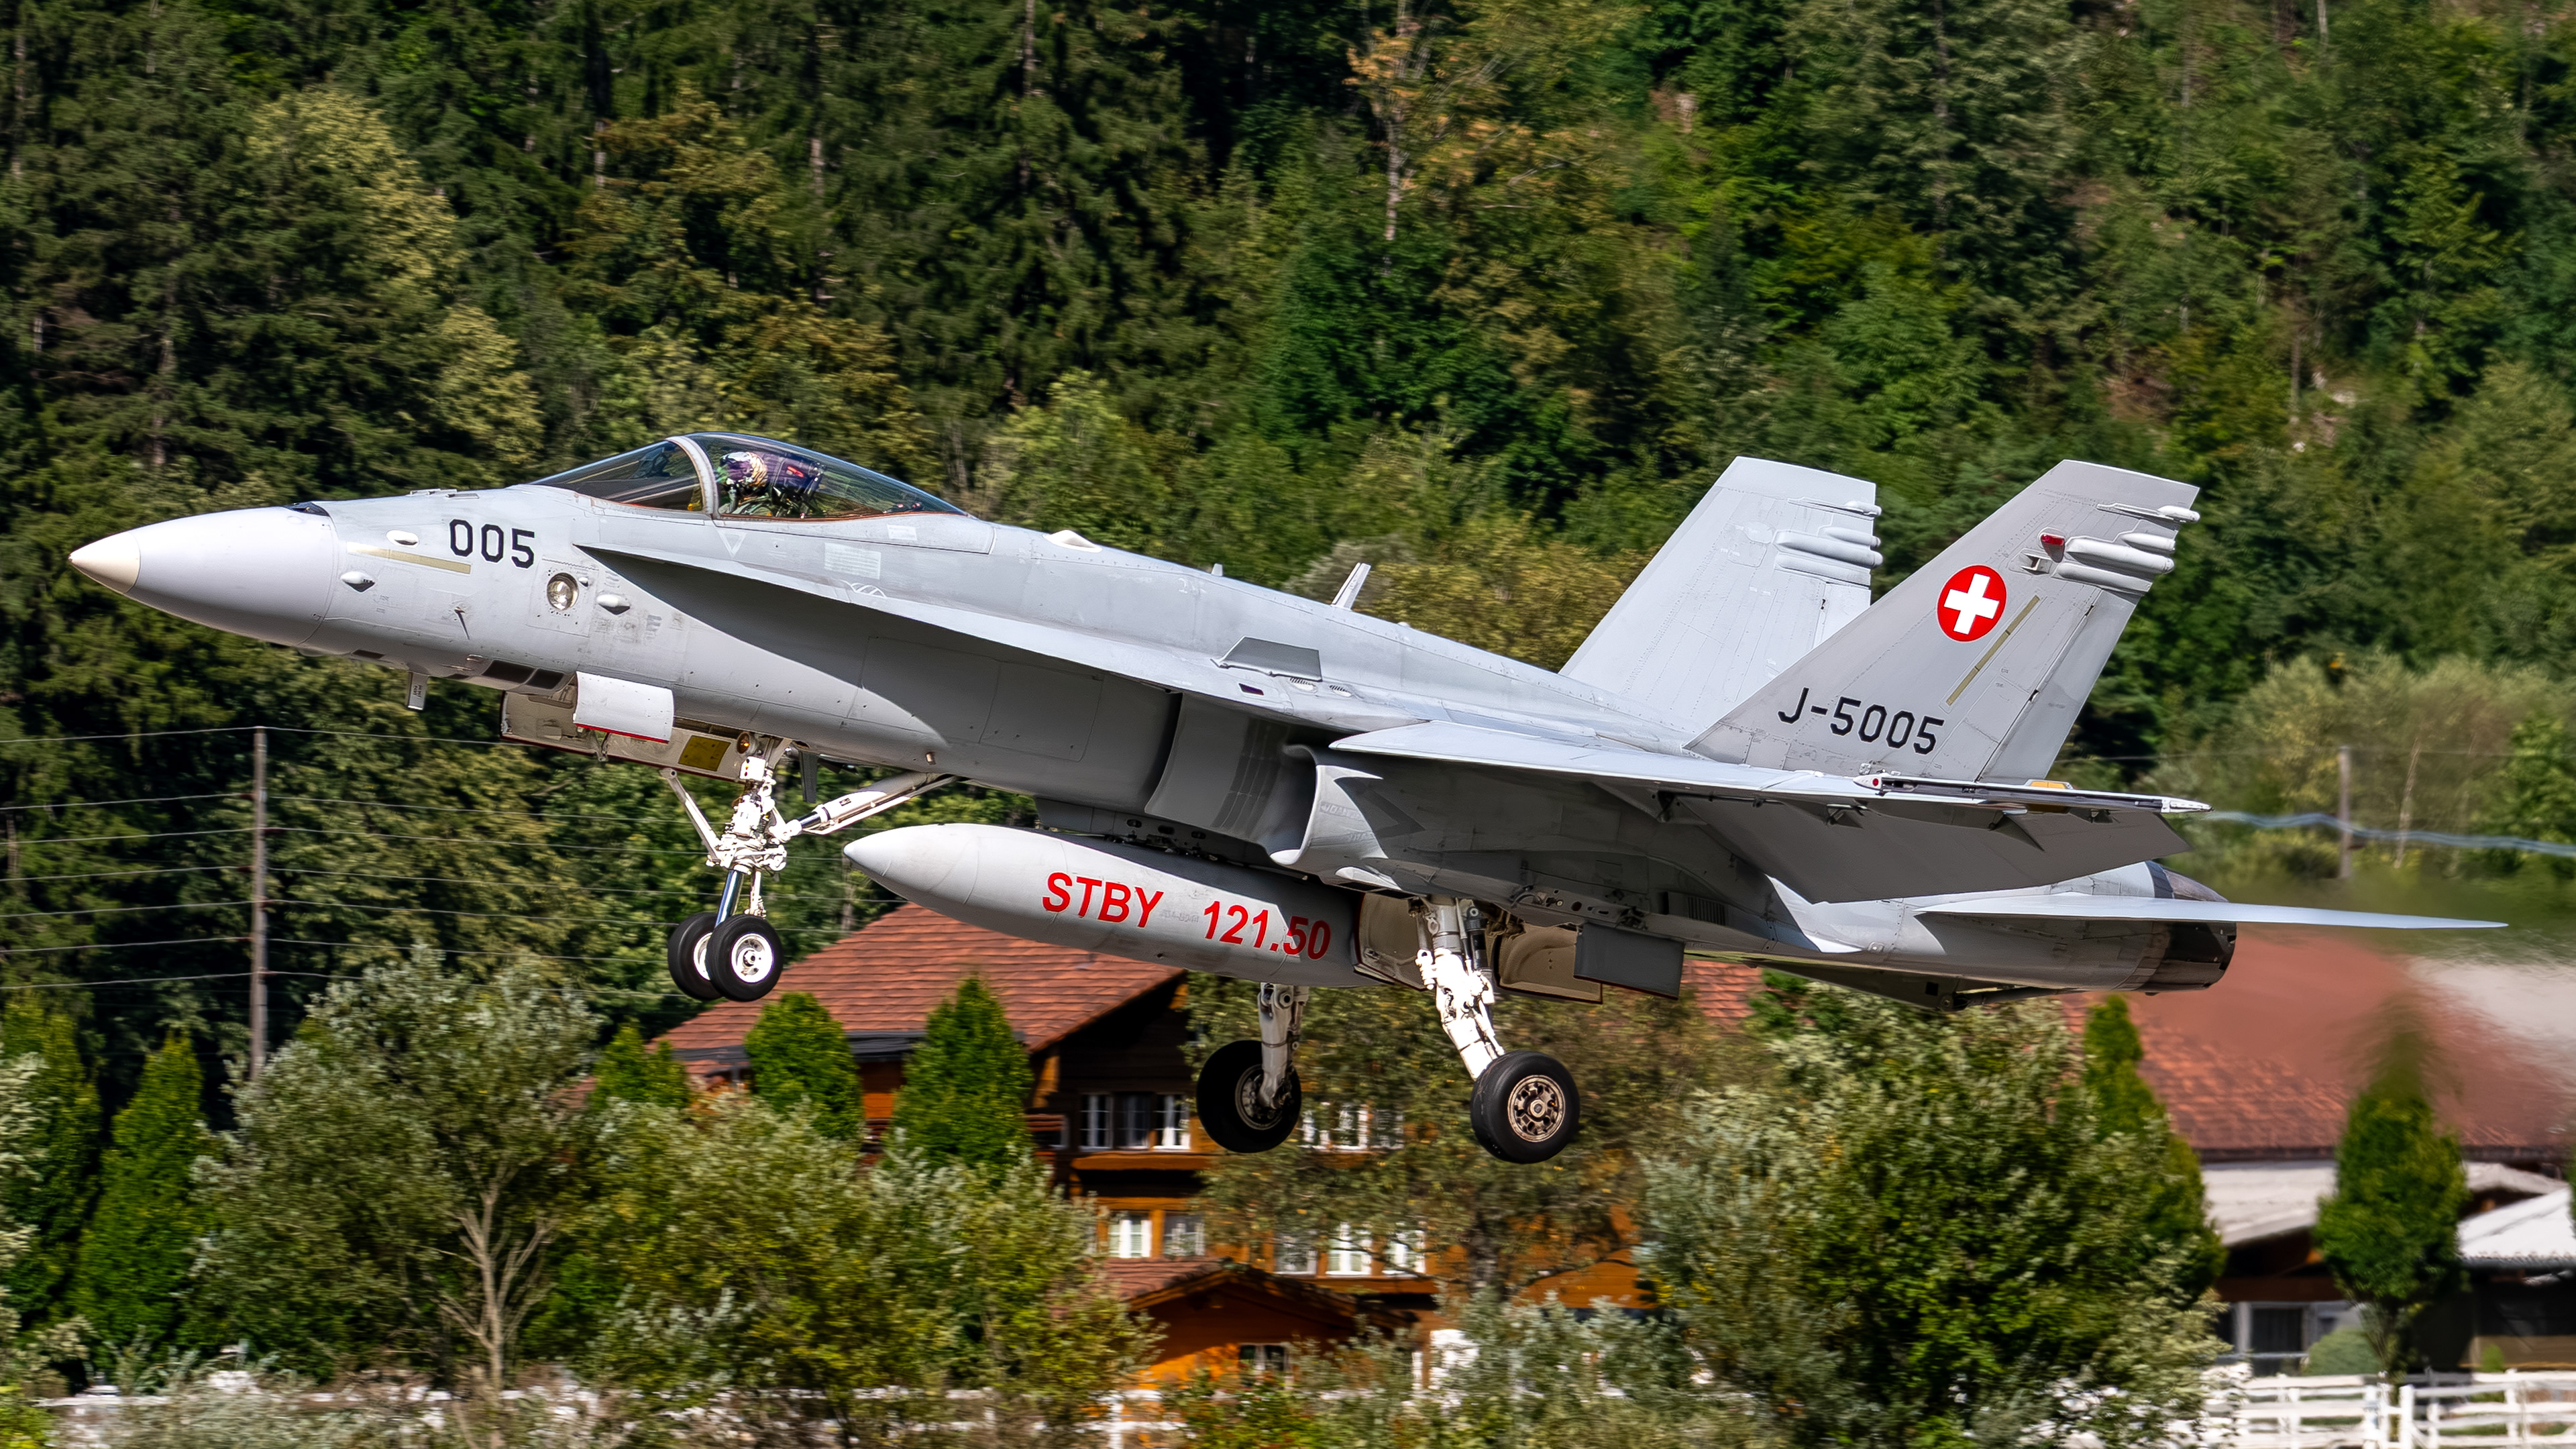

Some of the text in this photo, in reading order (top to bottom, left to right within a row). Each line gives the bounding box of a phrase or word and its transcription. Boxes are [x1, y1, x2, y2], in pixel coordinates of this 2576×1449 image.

[449, 519, 535, 569] 005
[1778, 687, 1945, 755] J-5005
[1042, 871, 1331, 960] STBY 121.50
